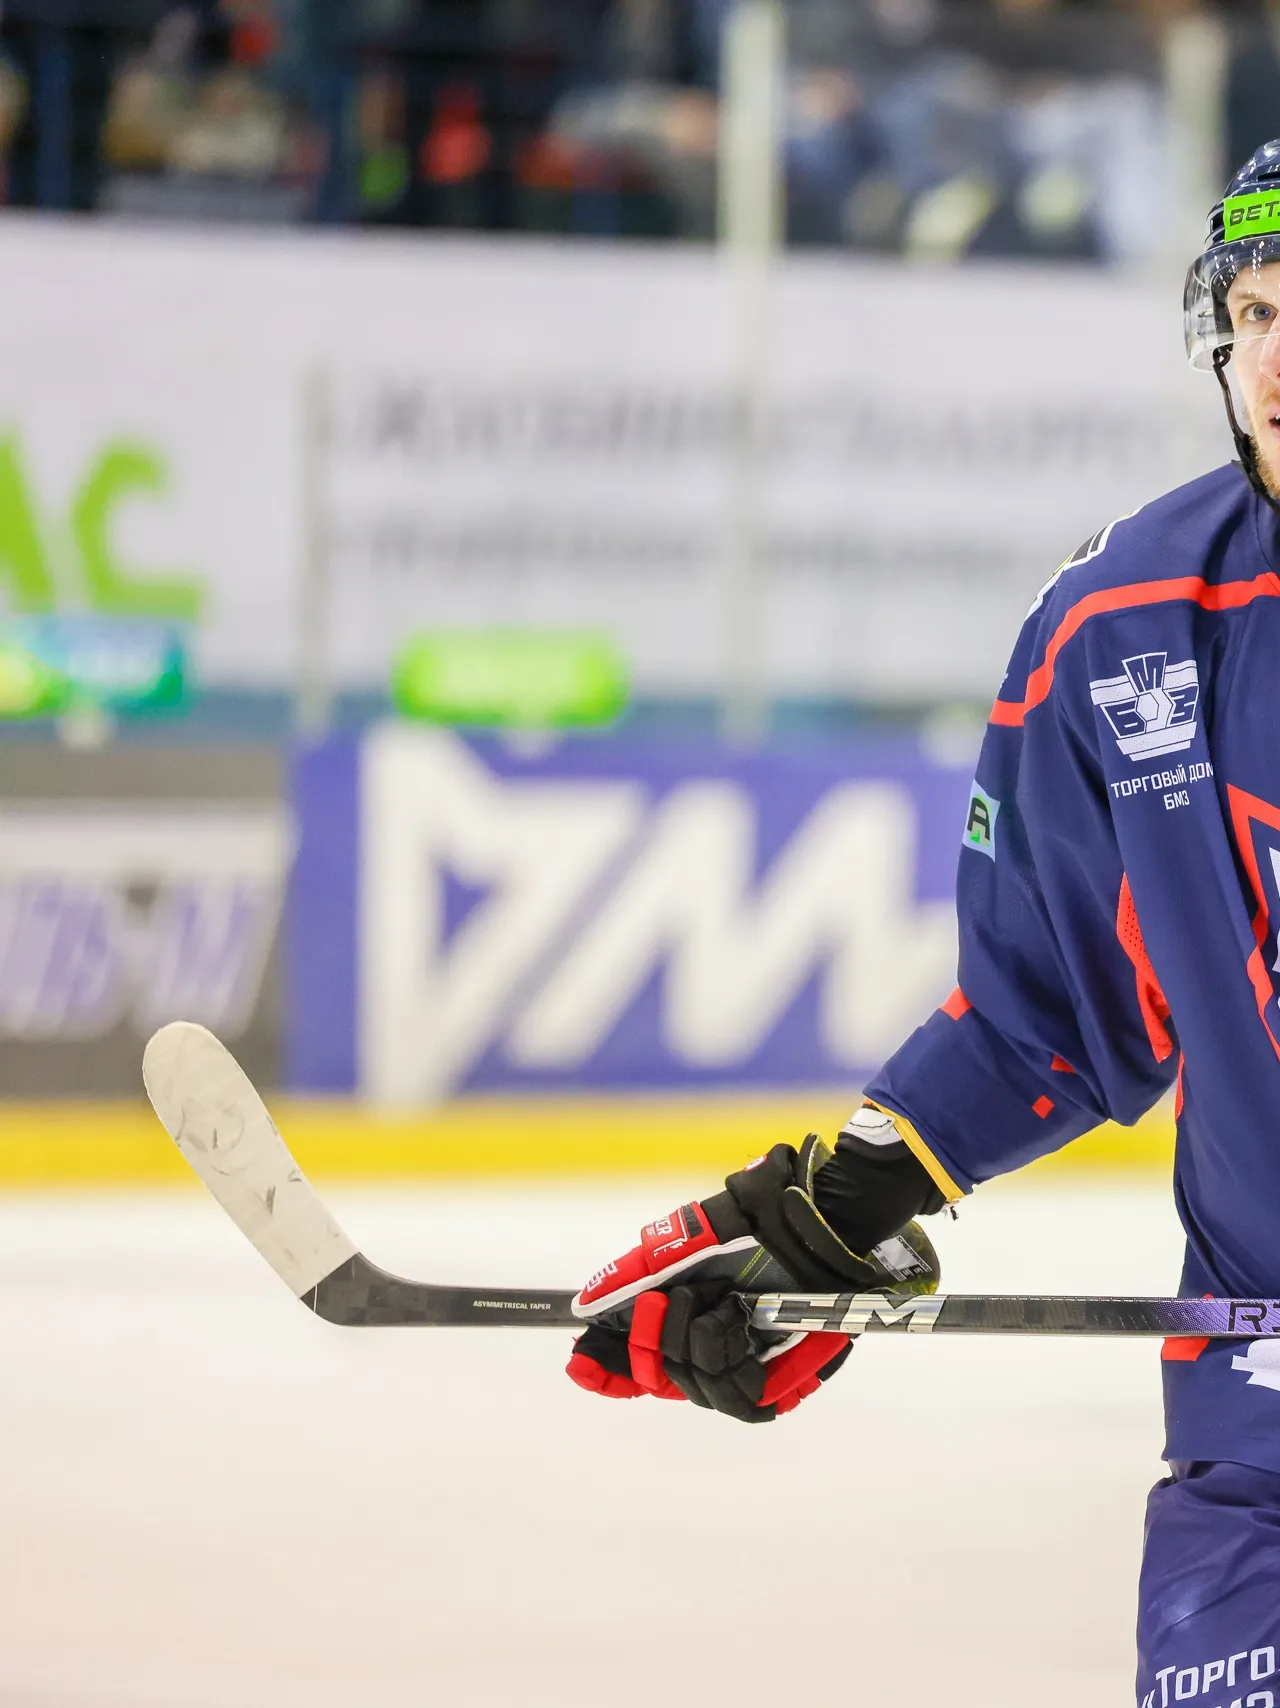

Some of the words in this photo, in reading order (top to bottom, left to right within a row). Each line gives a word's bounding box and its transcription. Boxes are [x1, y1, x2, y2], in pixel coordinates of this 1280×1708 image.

[1110, 764, 1188, 798] ТОРГОВЫЙ
[1163, 789, 1190, 811] БМЗ
[472, 1300, 529, 1310] ASYMMETRICAL
[529, 1303, 552, 1311] TAPER
